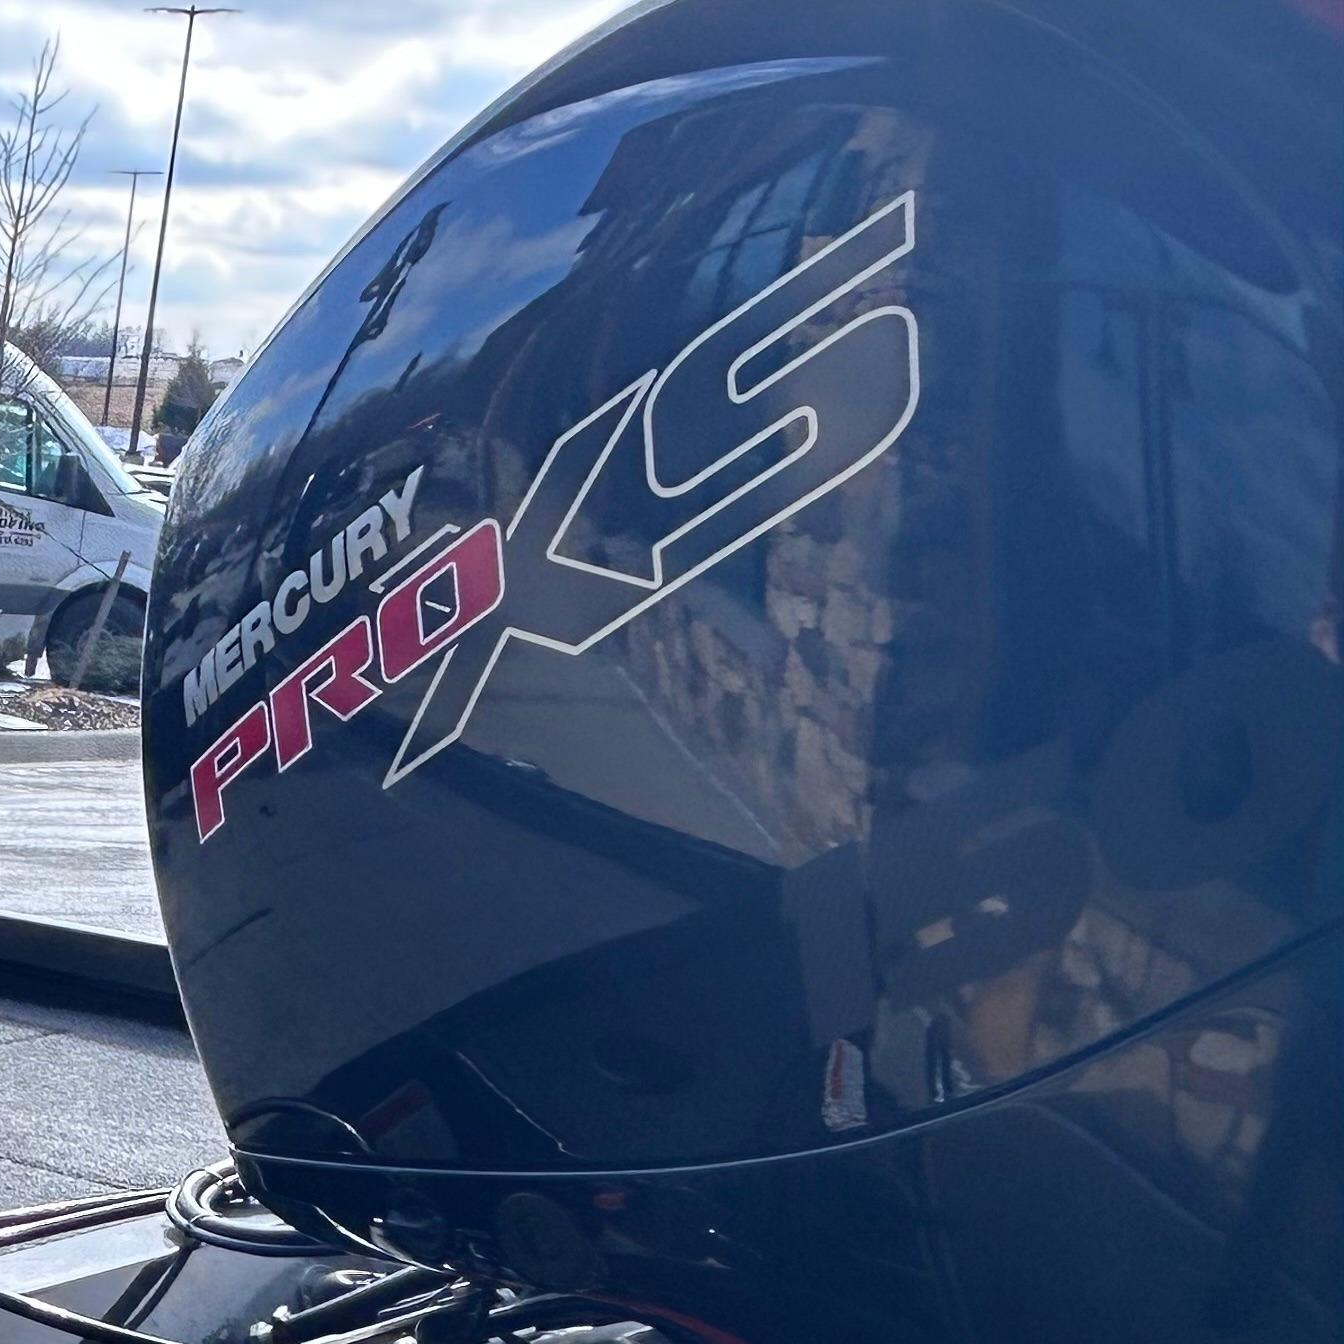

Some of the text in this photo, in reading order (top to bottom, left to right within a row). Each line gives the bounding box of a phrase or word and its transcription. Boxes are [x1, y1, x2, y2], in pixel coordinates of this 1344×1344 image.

[183, 464, 424, 727] MERCURY
[190, 190, 920, 844] PRO XS
